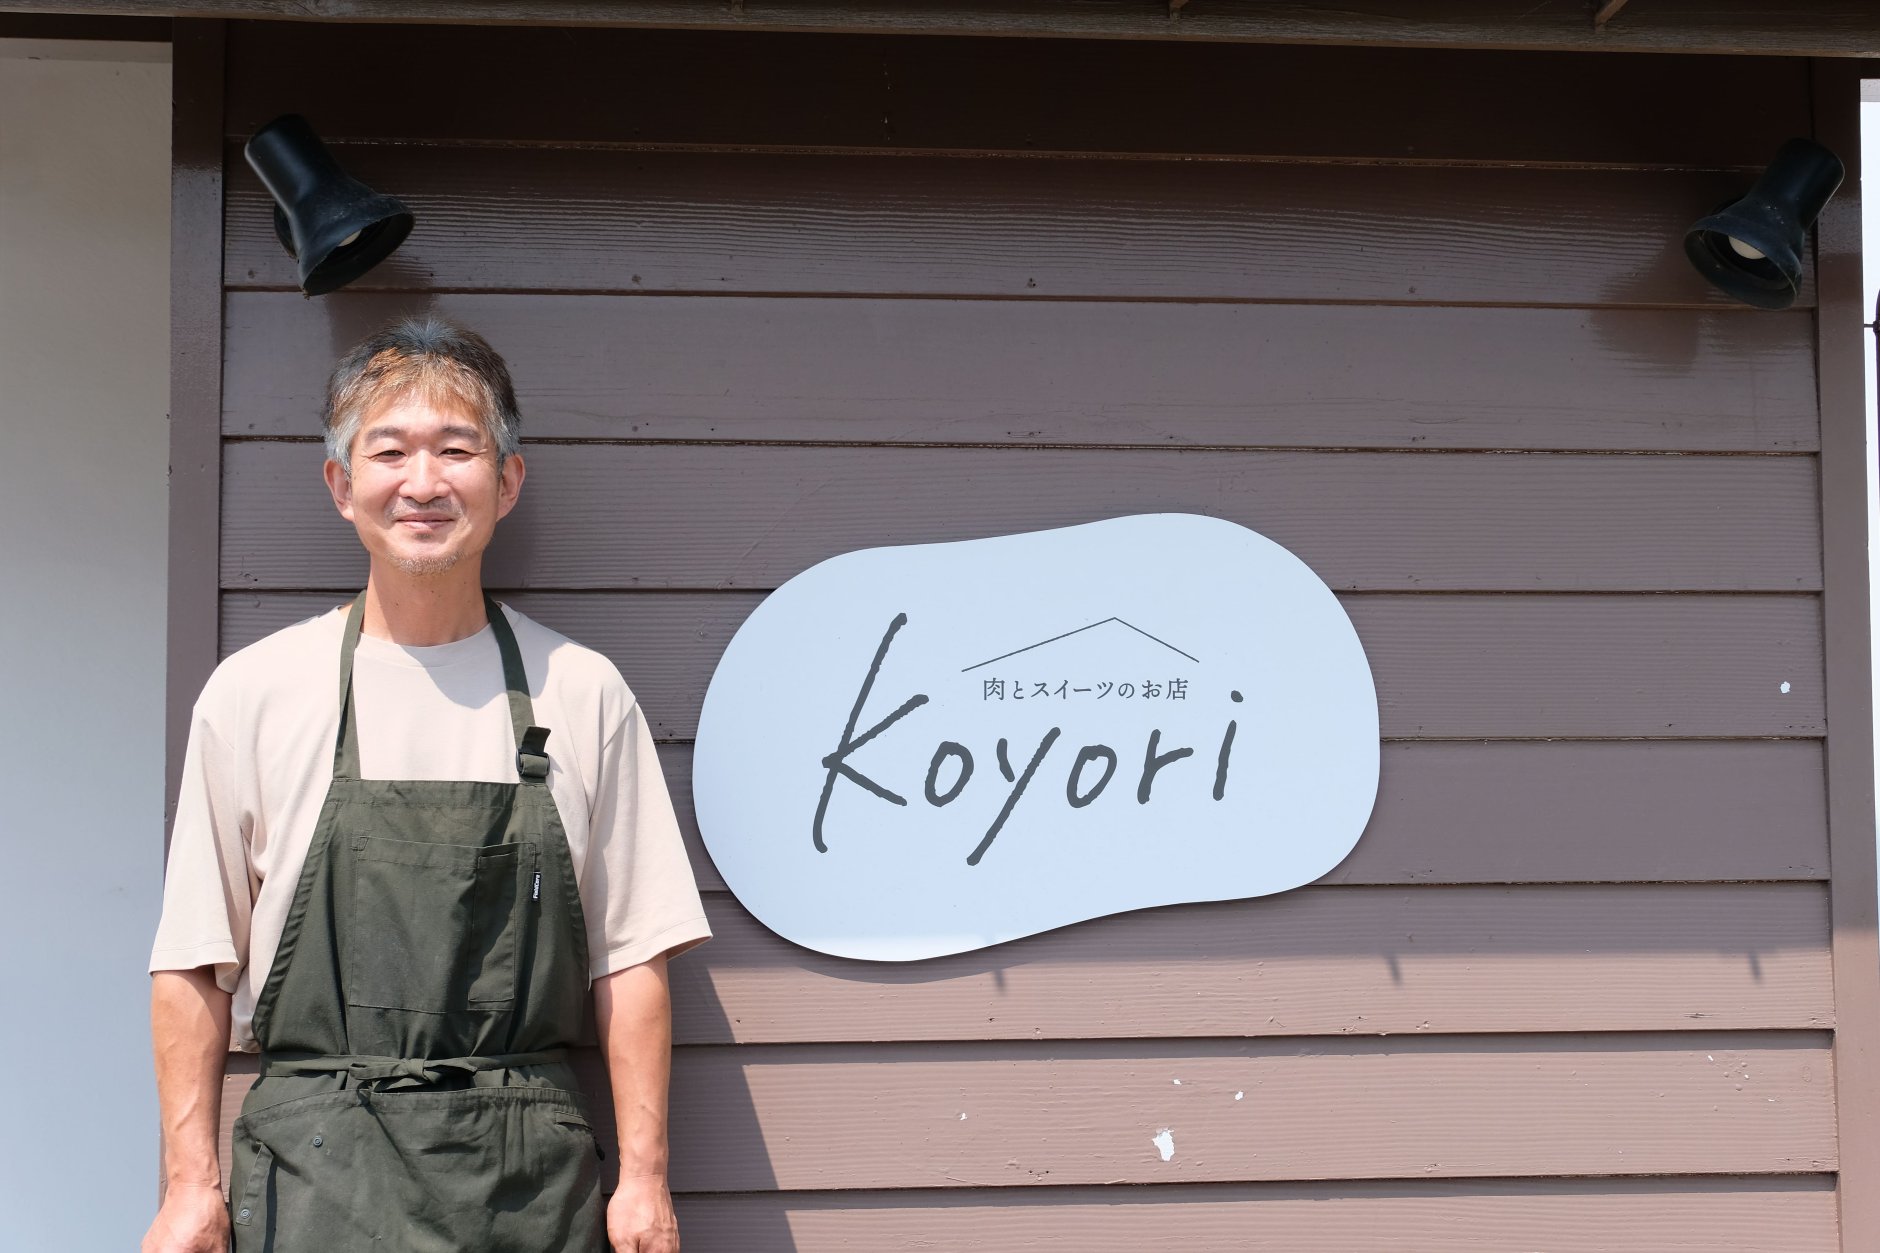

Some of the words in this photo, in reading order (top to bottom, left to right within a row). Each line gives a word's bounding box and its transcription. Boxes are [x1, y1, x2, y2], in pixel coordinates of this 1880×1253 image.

[983, 677, 1189, 701] 肉とスイーツのお店
